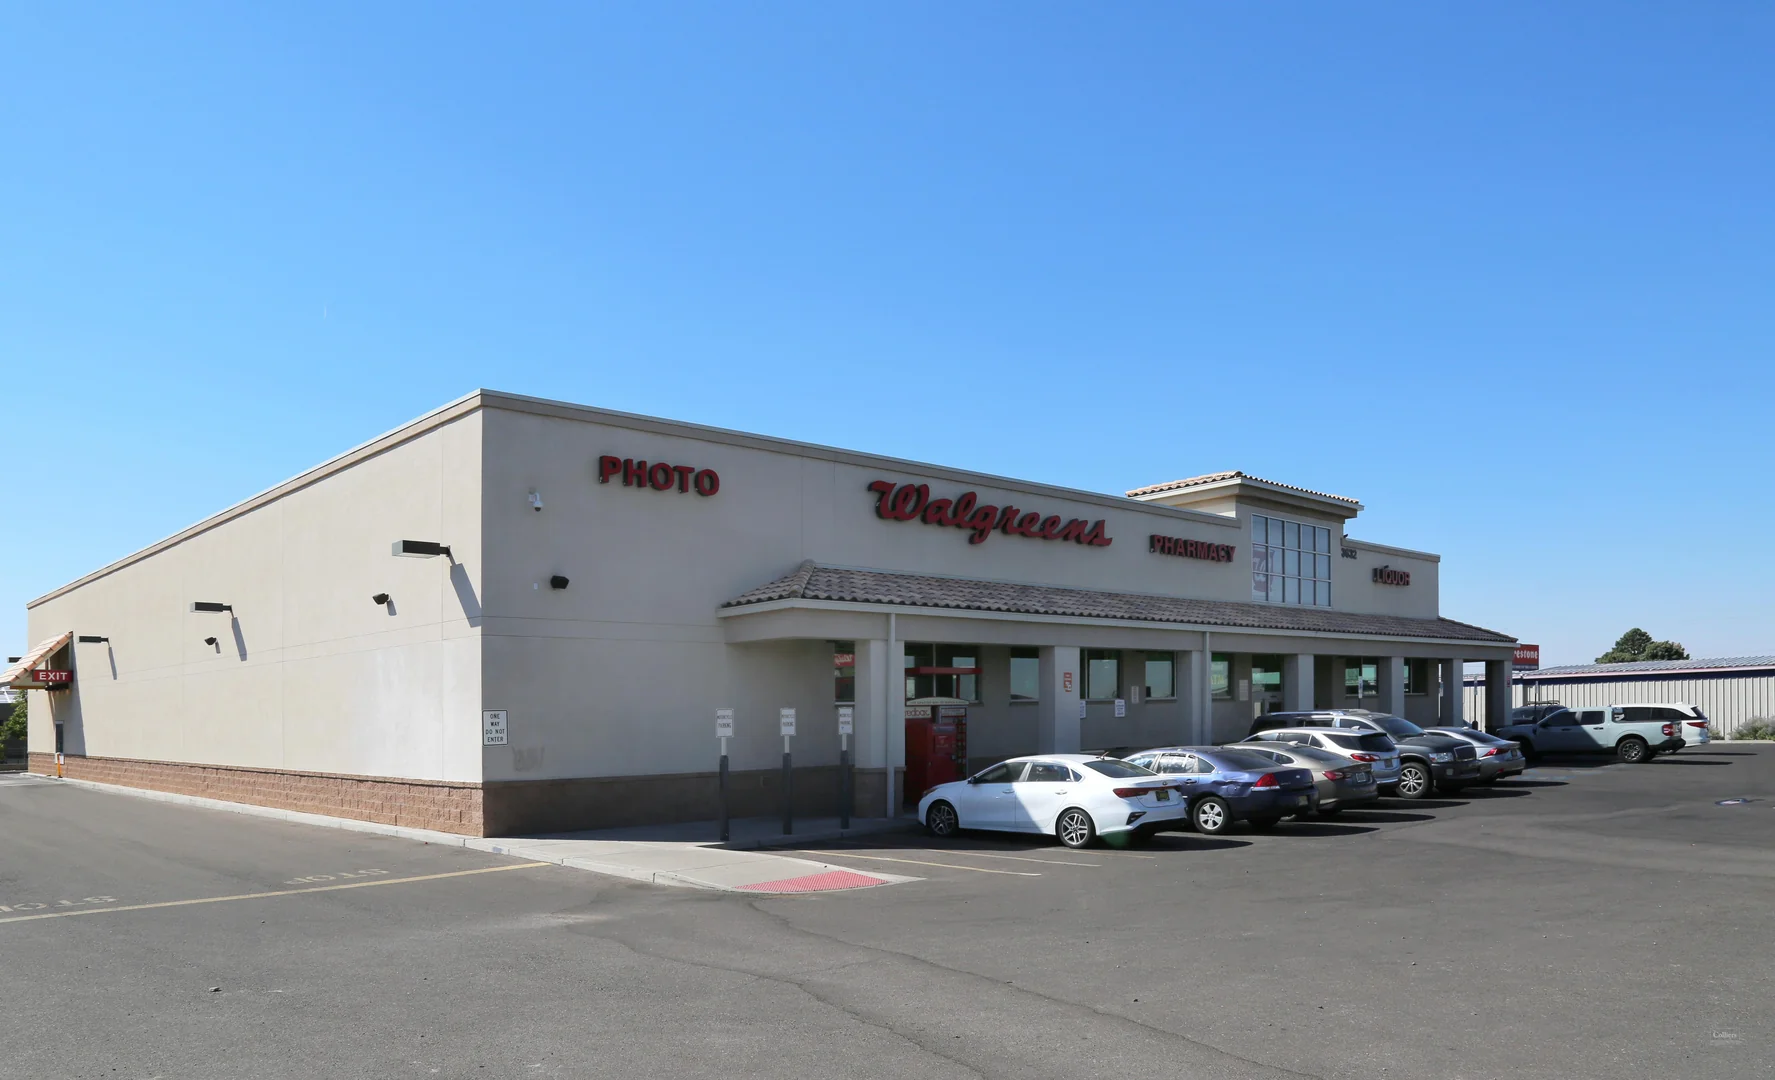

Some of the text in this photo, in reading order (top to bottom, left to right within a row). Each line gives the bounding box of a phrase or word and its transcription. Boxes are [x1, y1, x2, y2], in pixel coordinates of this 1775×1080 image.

[599, 455, 720, 496] PHOTO
[868, 480, 1113, 545] Walgreens
[1150, 534, 1236, 562] PHARMACY
[1372, 567, 1411, 586] LIQUOR
[39, 672, 67, 680] EXIT
[284, 868, 390, 885] STOP
